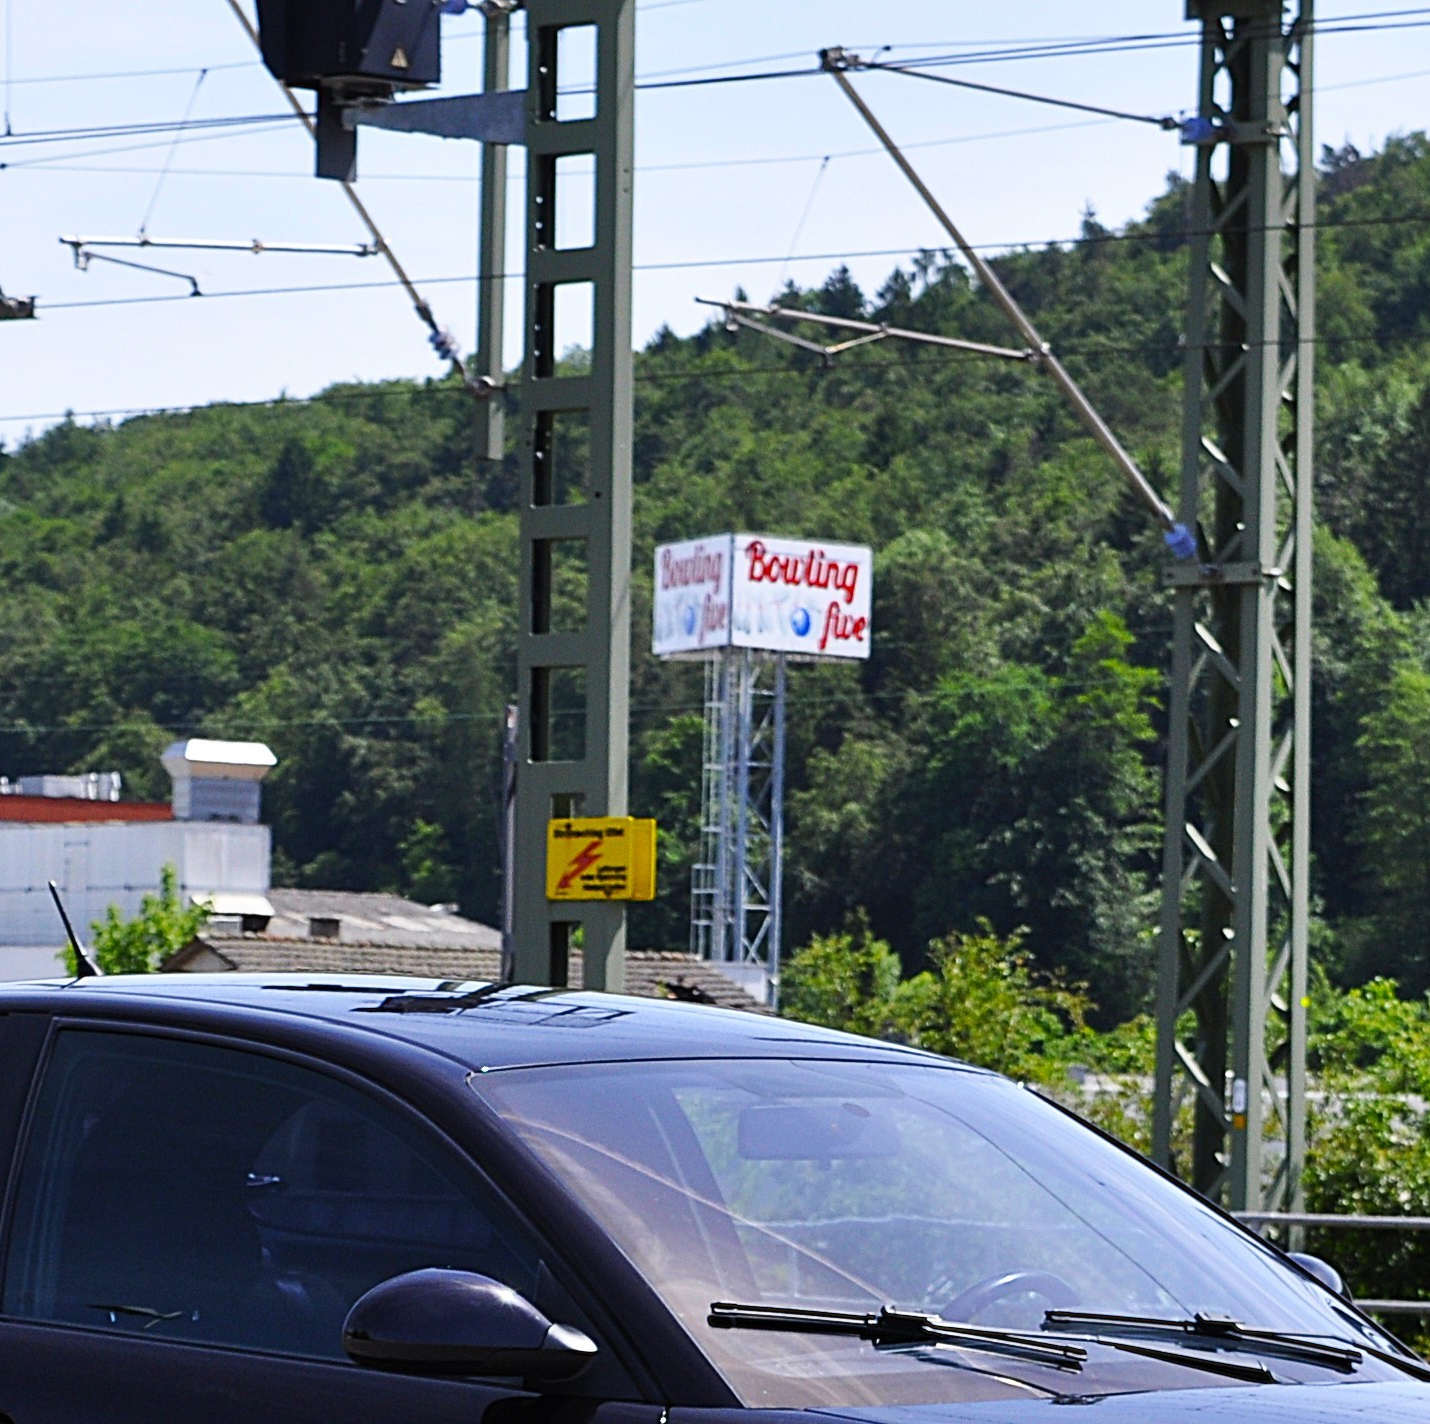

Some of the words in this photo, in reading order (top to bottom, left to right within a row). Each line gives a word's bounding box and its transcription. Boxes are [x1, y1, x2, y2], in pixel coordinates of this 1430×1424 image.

[662, 544, 723, 595] Bowling
[745, 540, 859, 604] Bowling
[818, 601, 866, 650] five
